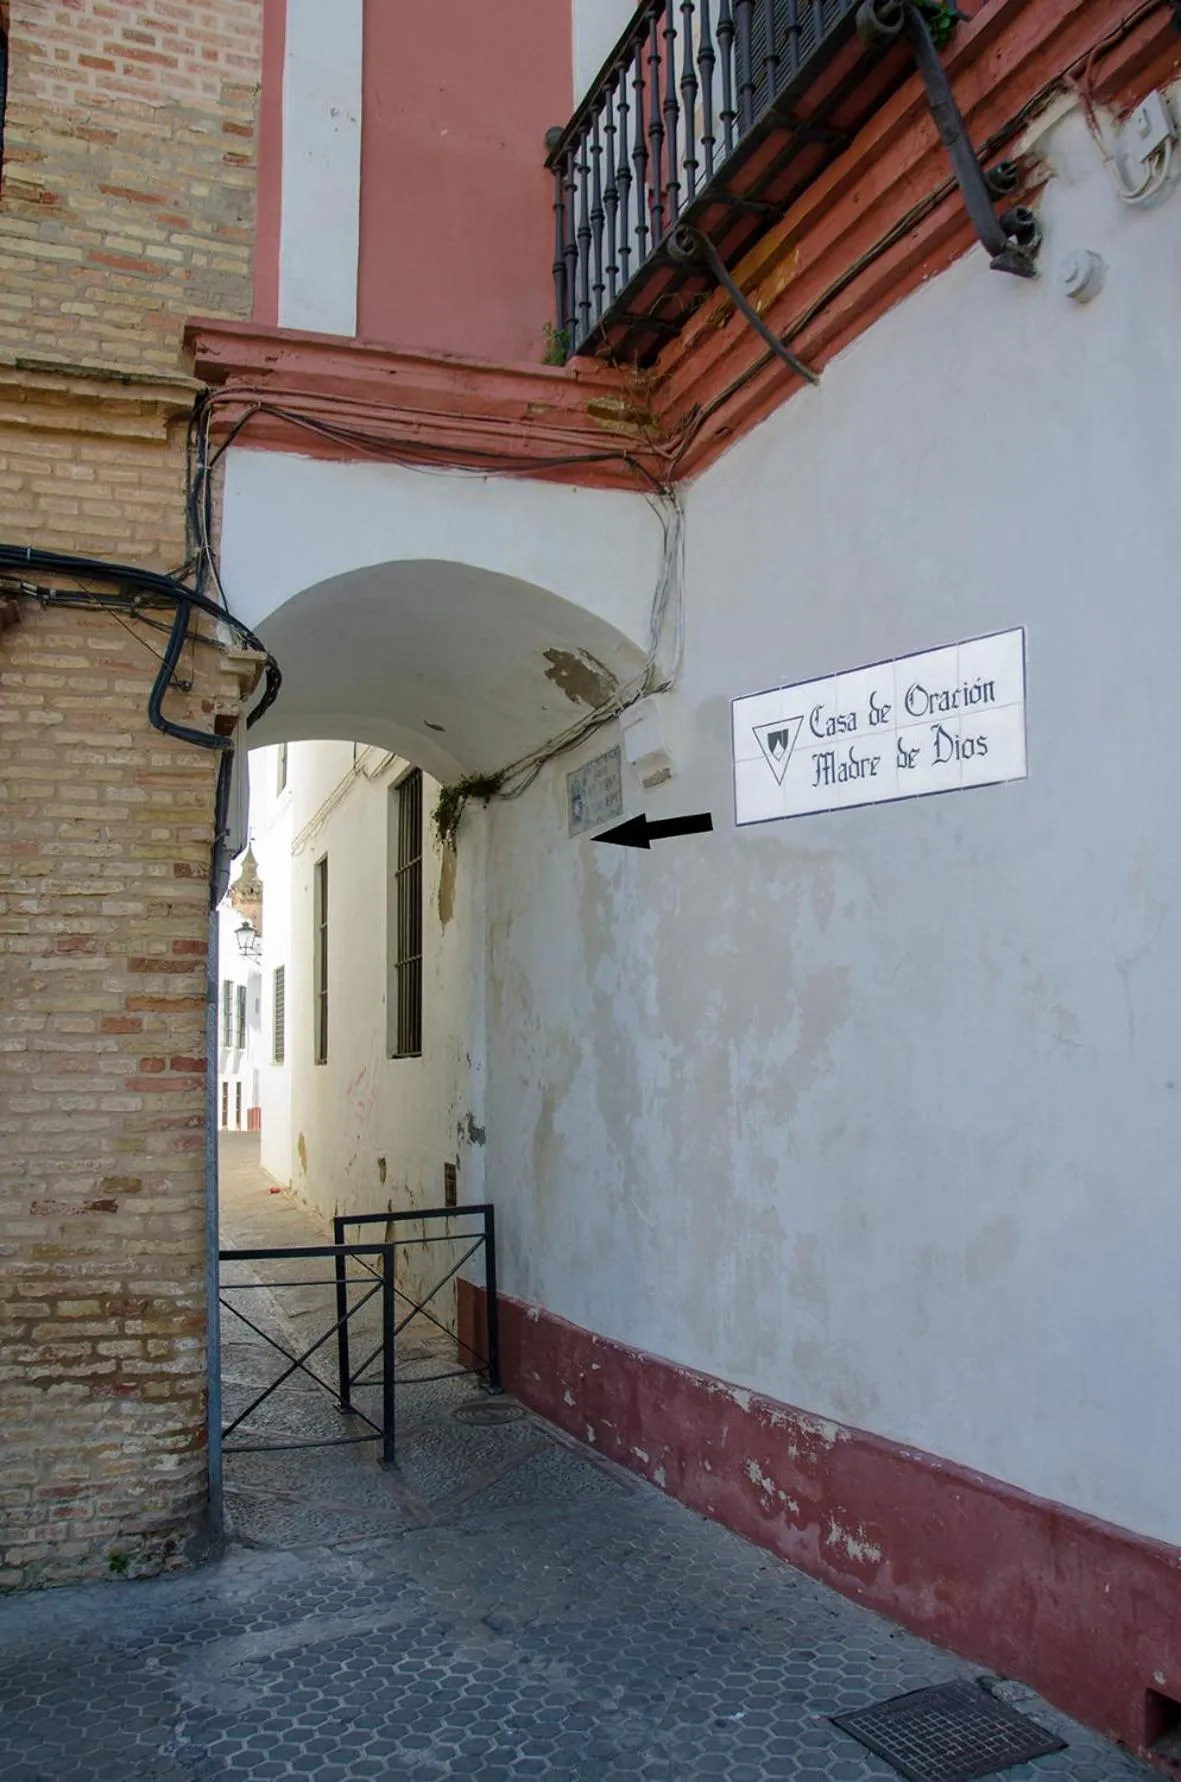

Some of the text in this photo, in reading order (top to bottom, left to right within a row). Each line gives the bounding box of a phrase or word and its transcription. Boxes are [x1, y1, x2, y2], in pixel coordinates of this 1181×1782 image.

[809, 677, 995, 738] Casa de Oración
[811, 723, 988, 788] Madre de Dios
